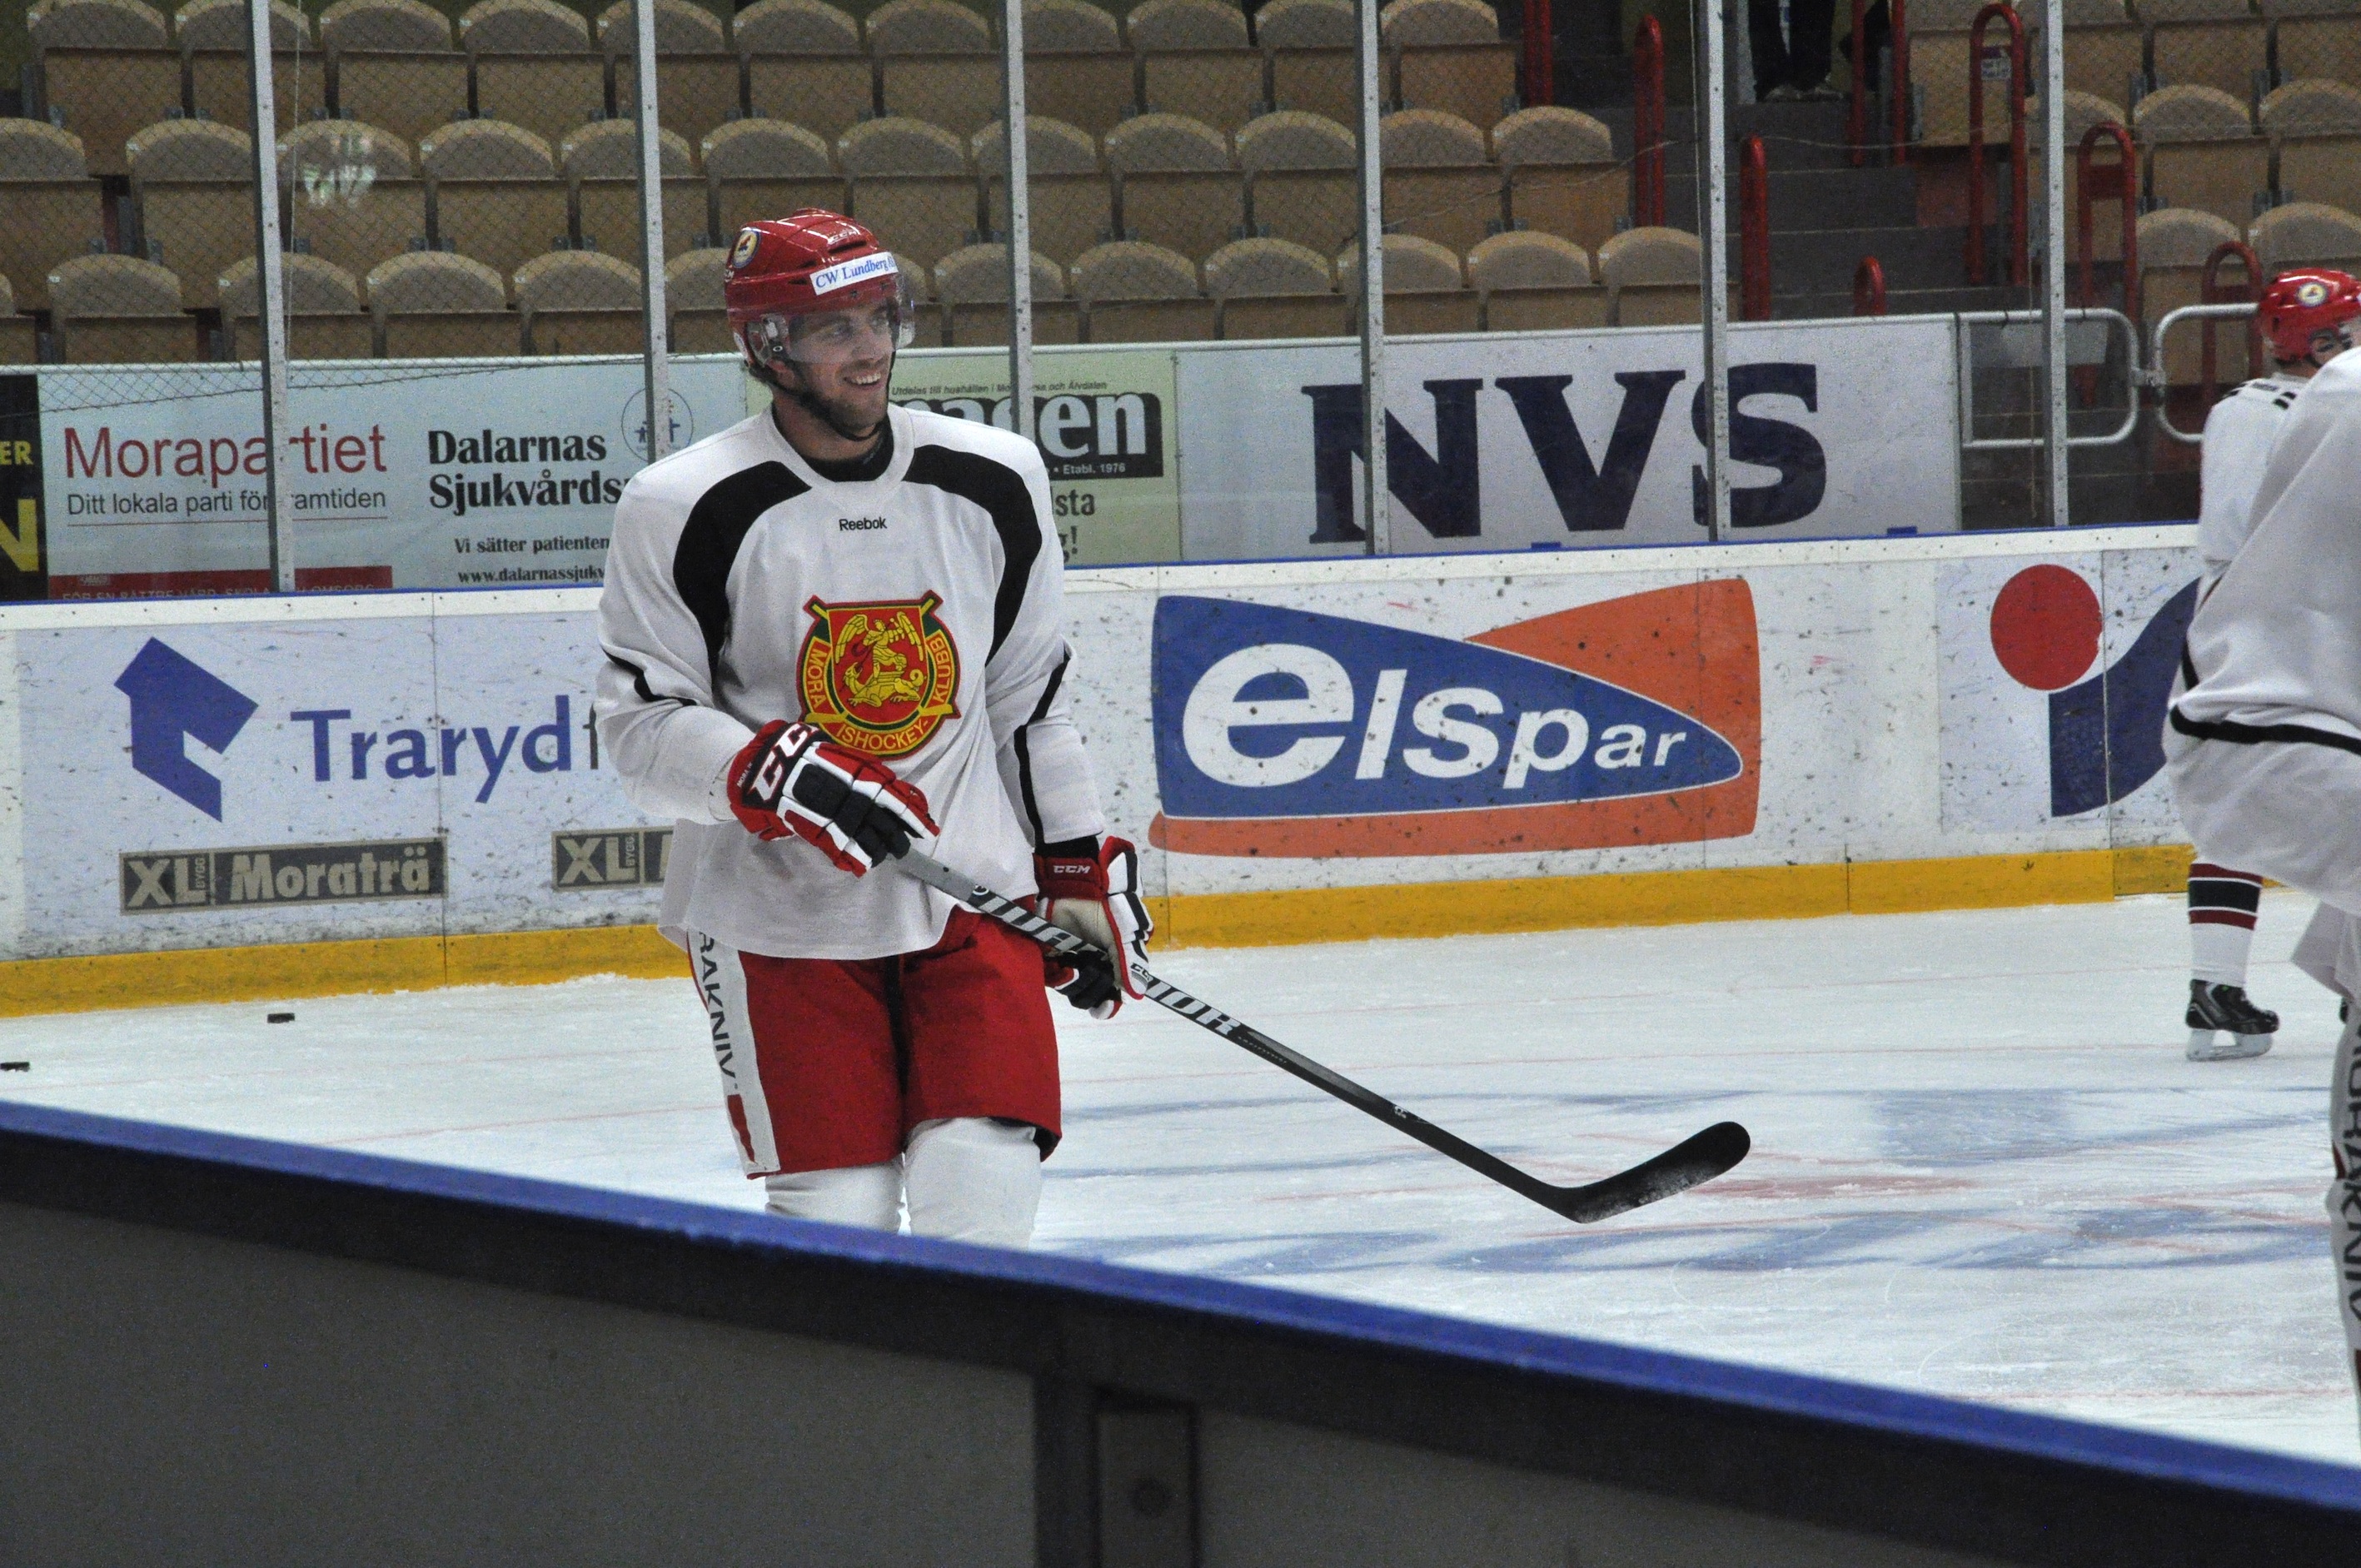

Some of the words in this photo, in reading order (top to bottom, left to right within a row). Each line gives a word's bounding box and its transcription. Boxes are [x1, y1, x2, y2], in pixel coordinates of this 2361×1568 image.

[815, 270, 839, 288] CW
[842, 259, 888, 280] Lundberg
[428, 429, 607, 465] Dalarnas
[1063, 464, 1096, 475] Etabl.
[1100, 462, 1126, 473] 1976
[1301, 362, 1826, 545] NVS
[67, 493, 106, 515] Ditt
[113, 492, 178, 514] lokala
[187, 490, 233, 516] parti
[291, 487, 386, 510] amtiden
[429, 469, 630, 516] Sjukvårds
[454, 537, 471, 554] Vi
[476, 535, 526, 553] sätter
[533, 535, 610, 557] patienten
[839, 516, 888, 531] Reebok
[807, 646, 826, 708] MORA
[929, 636, 951, 704] KLUBB
[1181, 642, 1687, 790] elspar
[750, 723, 819, 801] CC
[127, 857, 206, 908] XL
[195, 857, 207, 890] BYGG
[229, 846, 430, 903] Moraträ
[559, 836, 637, 884] XL
[1053, 864, 1091, 874] CCM
